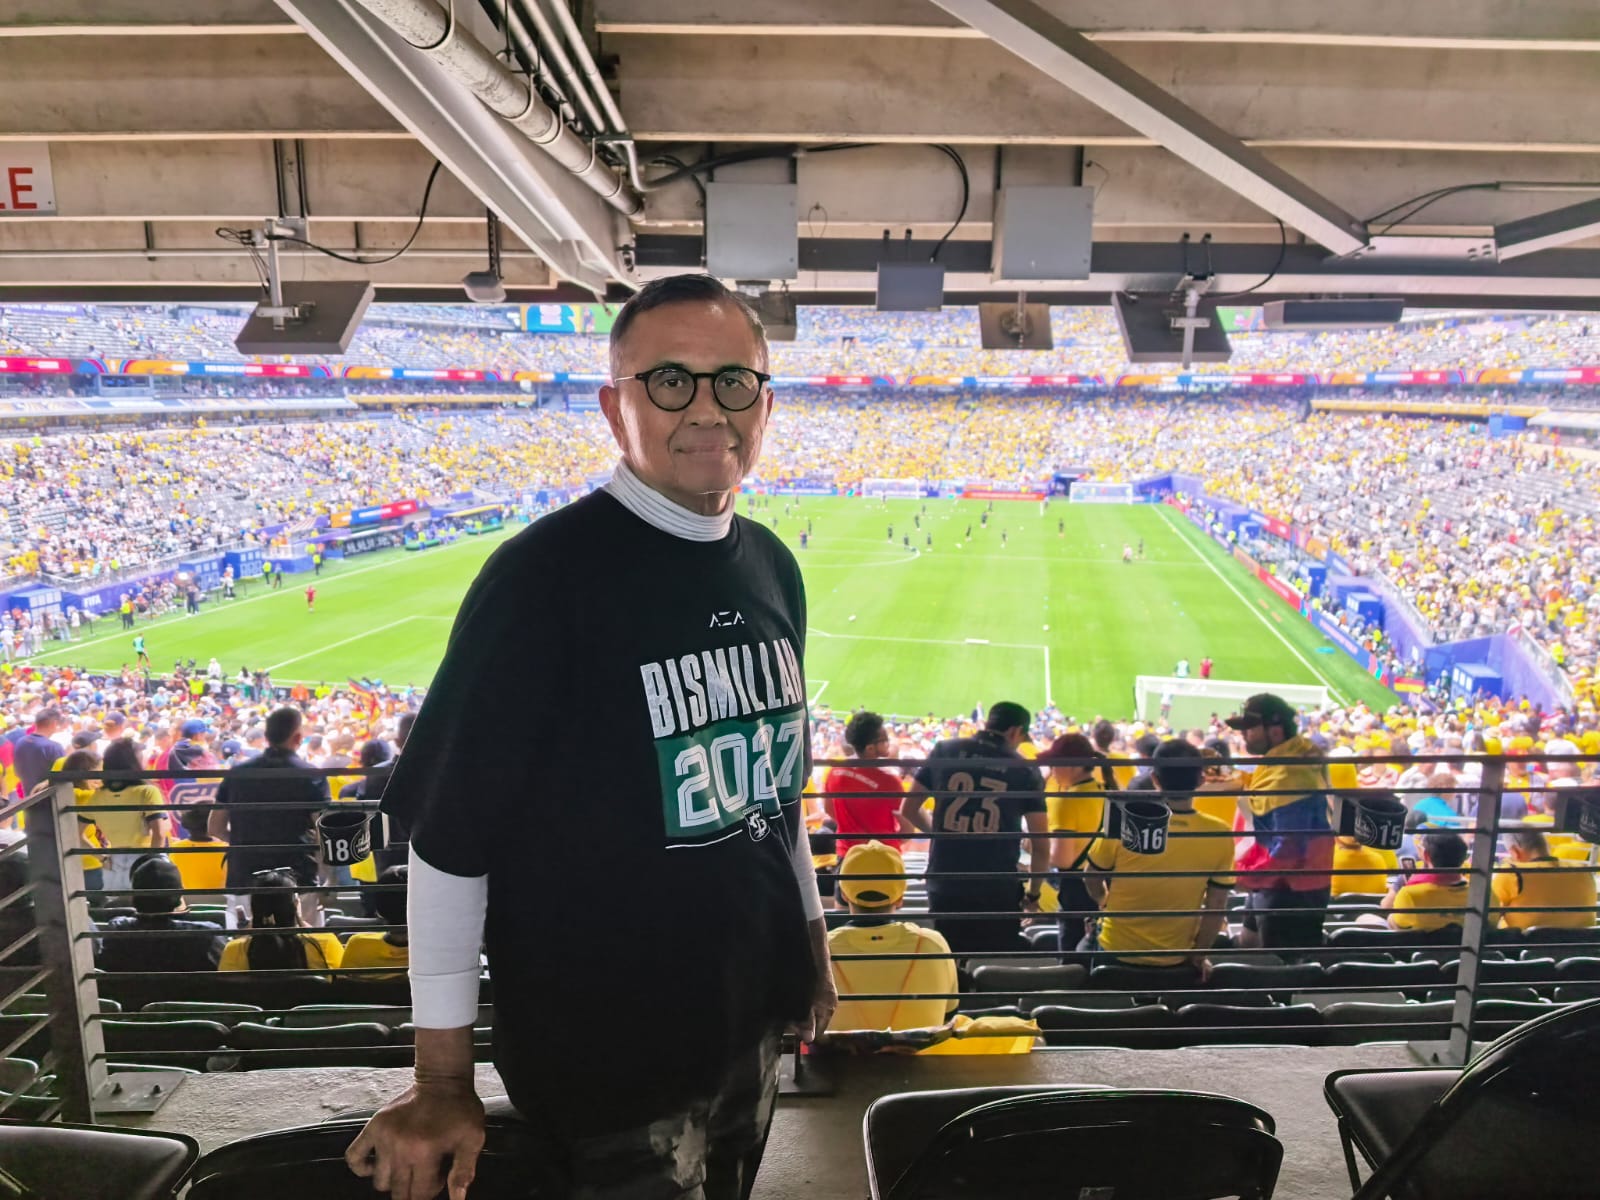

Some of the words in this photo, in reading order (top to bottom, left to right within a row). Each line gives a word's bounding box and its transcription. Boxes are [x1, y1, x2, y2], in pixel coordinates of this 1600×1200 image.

[0, 167, 37, 209] E
[640, 638, 802, 738] BISMILLAH
[674, 719, 803, 827] 2027
[943, 772, 1008, 833] 23
[325, 839, 349, 862] 18
[1141, 828, 1163, 850] 16
[1380, 824, 1401, 846] 15
